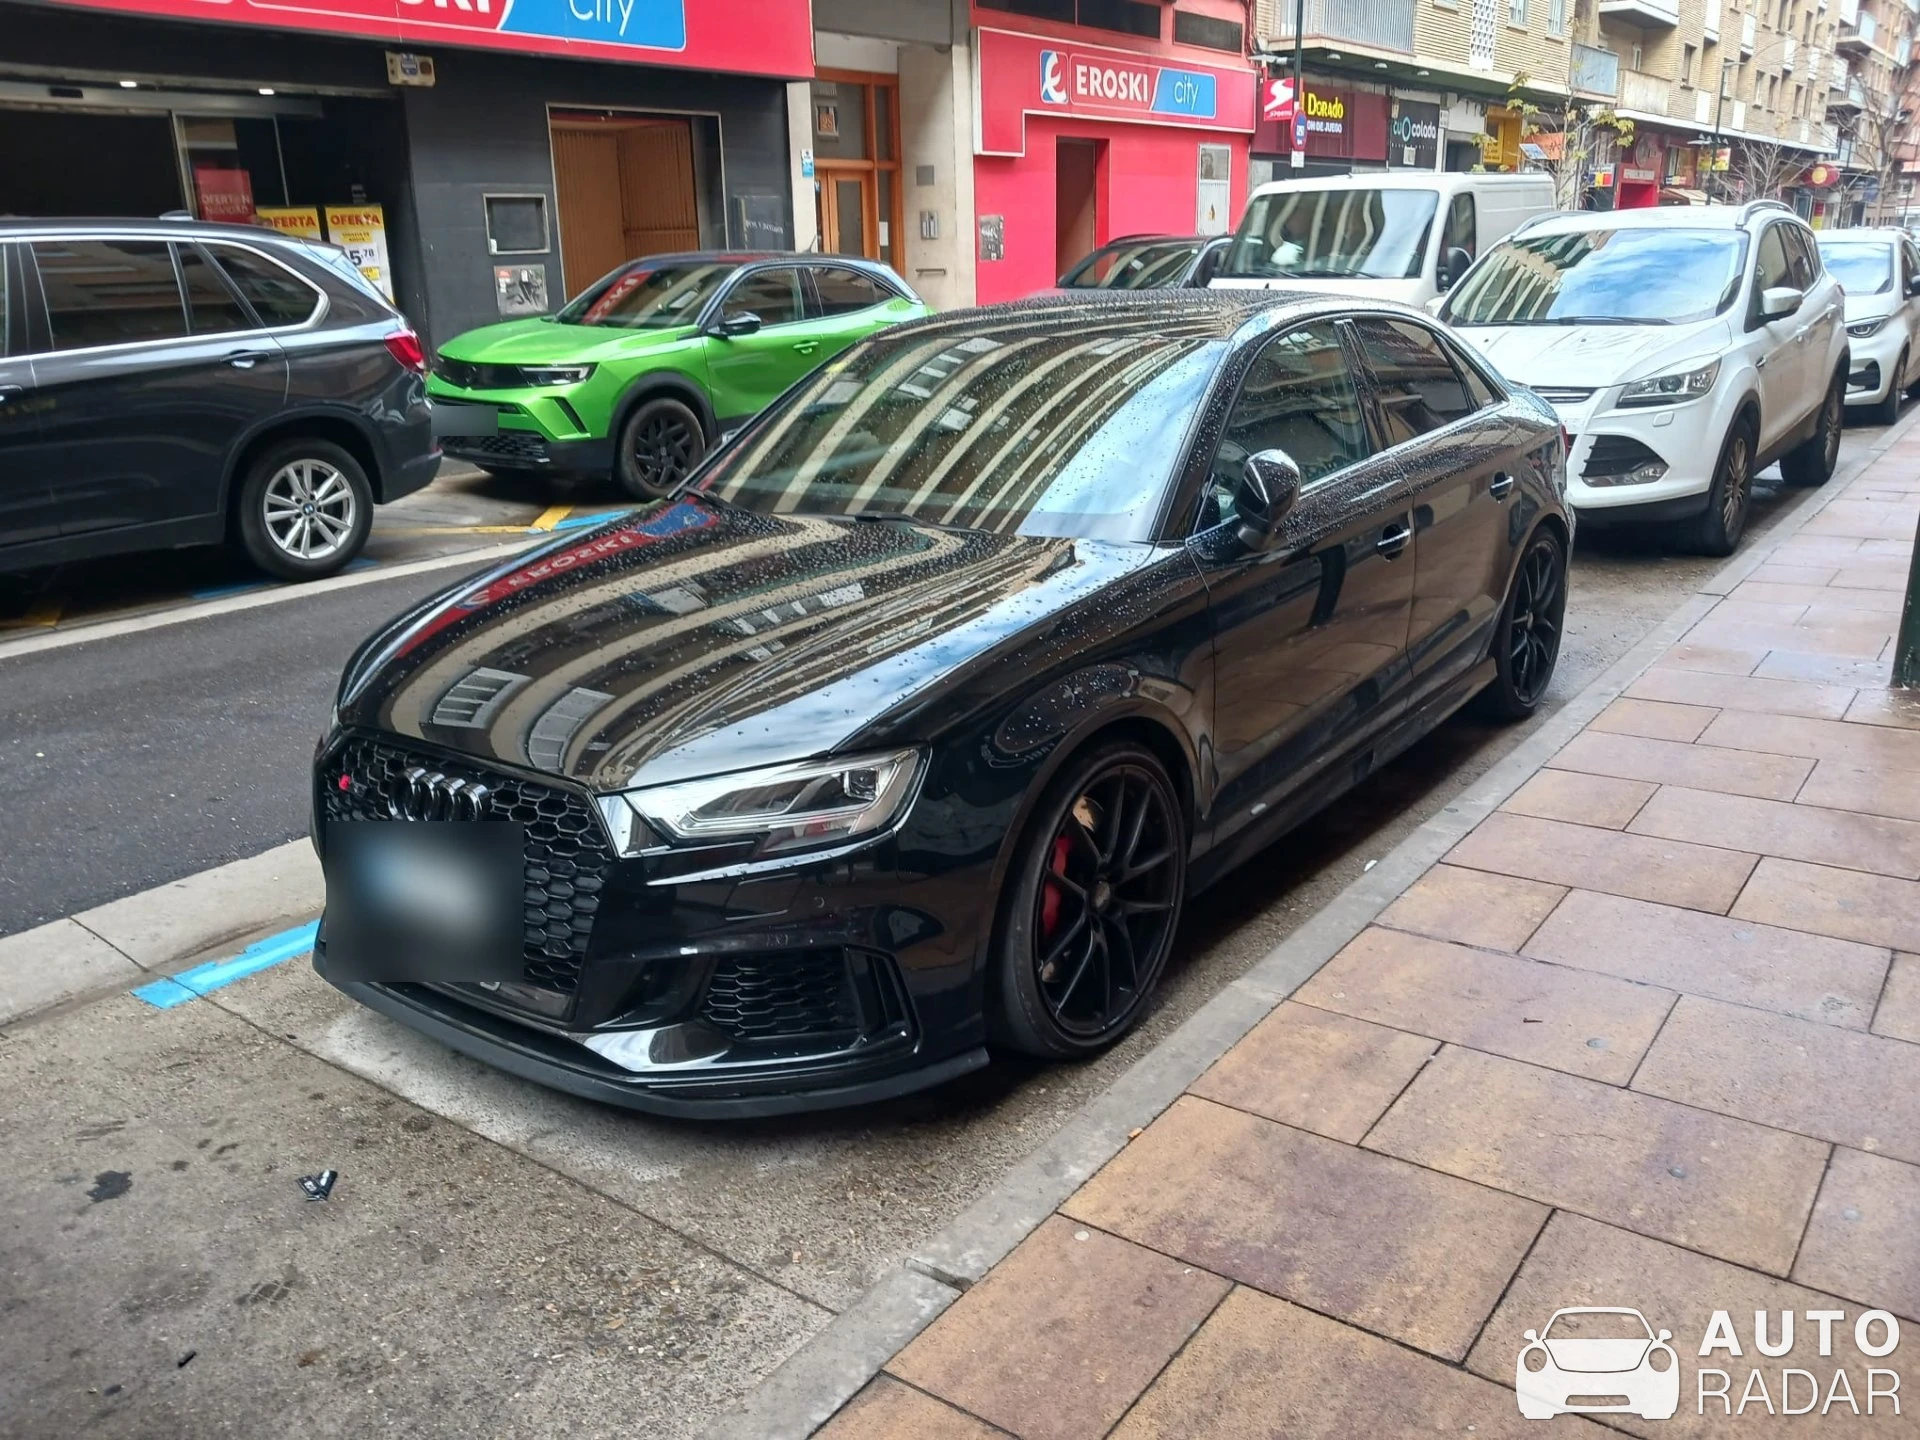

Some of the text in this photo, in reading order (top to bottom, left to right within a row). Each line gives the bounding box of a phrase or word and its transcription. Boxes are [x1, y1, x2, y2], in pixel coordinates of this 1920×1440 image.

[1075, 64, 1199, 111] EROSKI city
[330, 213, 381, 226] OFERTA
